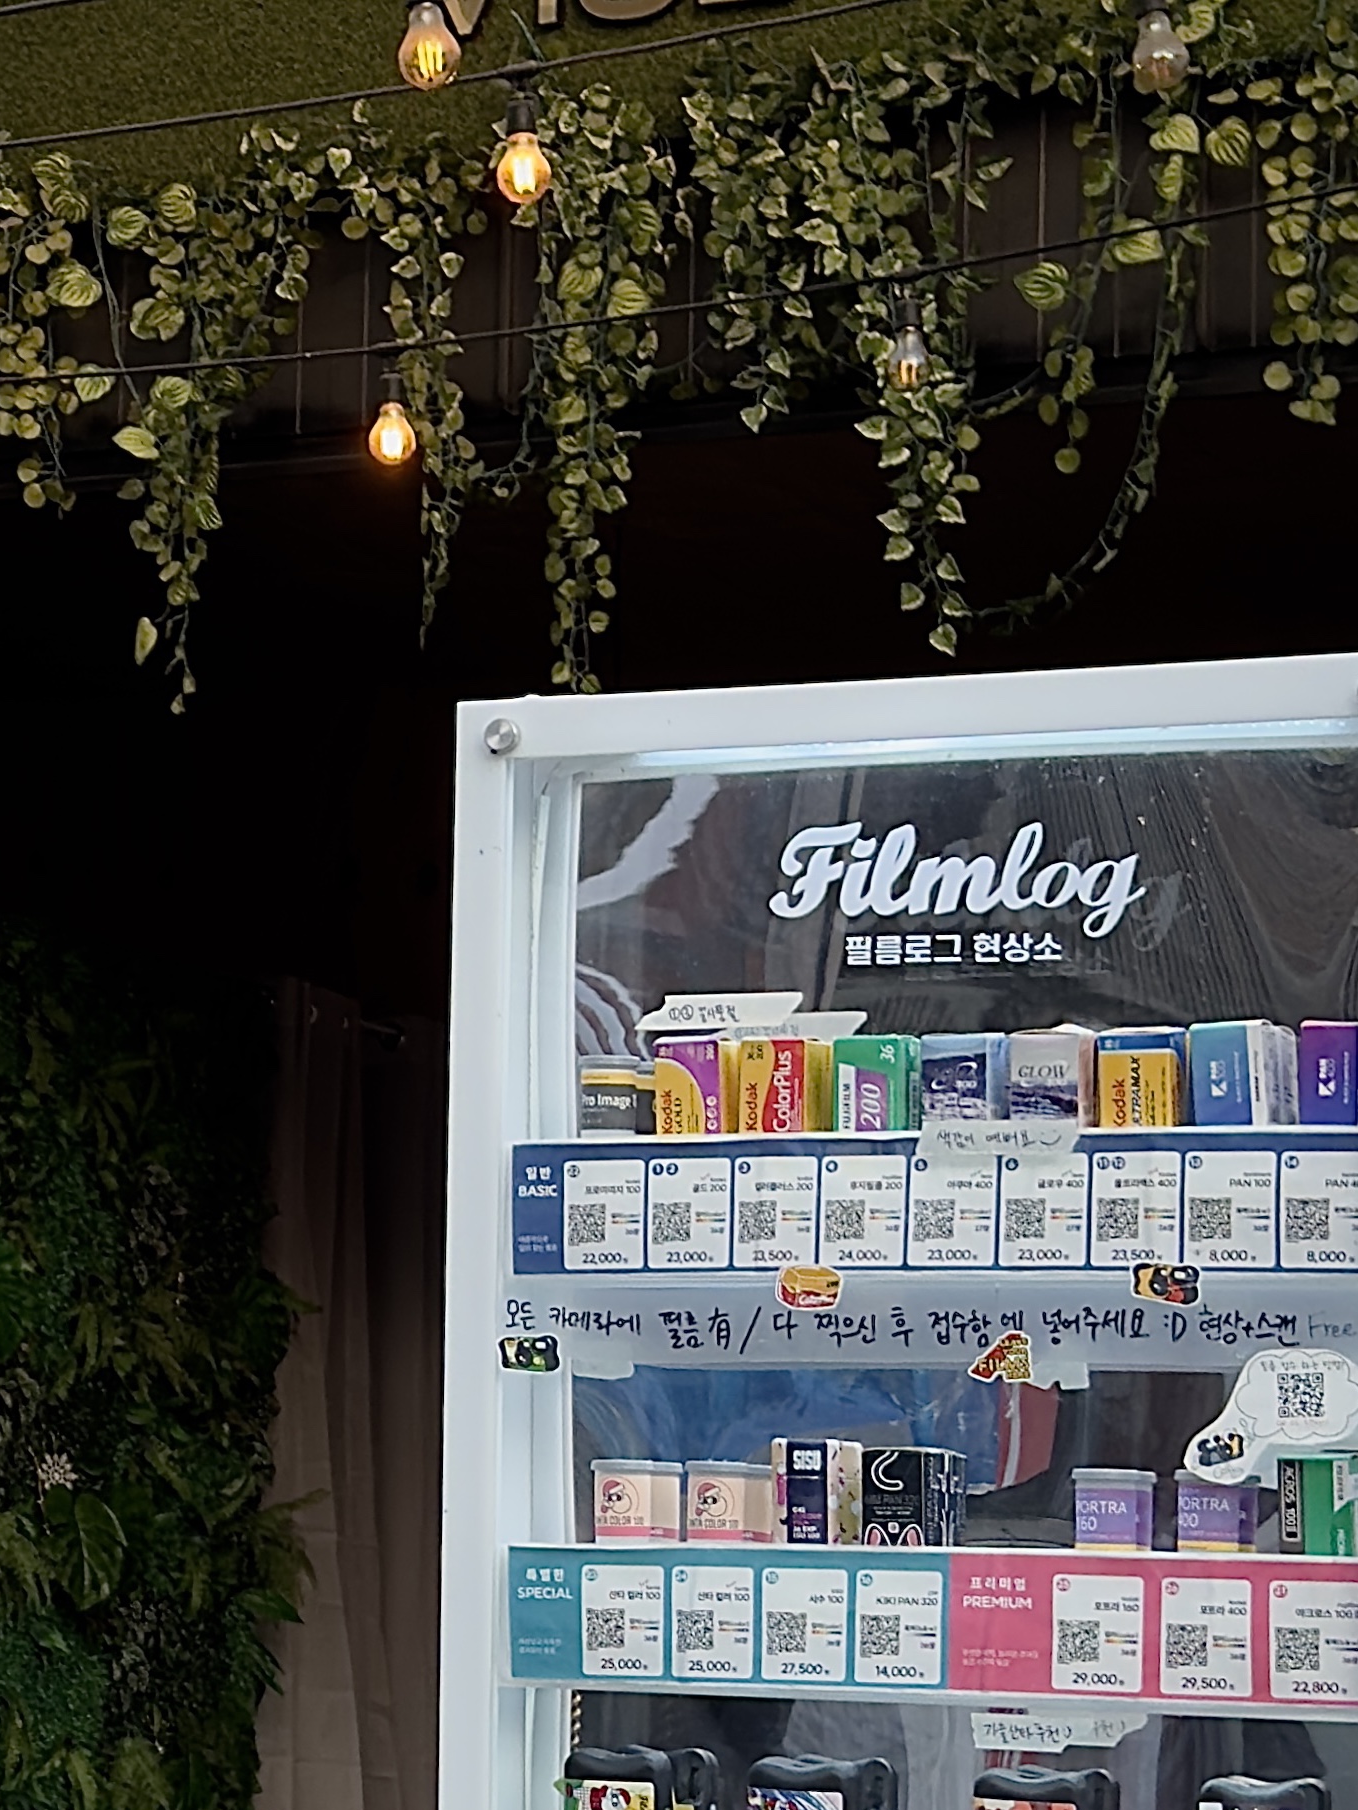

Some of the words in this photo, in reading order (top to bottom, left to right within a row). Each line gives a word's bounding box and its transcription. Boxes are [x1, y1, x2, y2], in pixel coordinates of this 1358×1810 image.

[769, 822, 1147, 938] Filmlog
[845, 934, 962, 965] 필름로그
[973, 933, 1062, 963] 현상소
[880, 1045, 895, 1064] 36
[1018, 1064, 1070, 1079] GLOW
[772, 1050, 793, 1133] ColorPlus
[597, 1095, 631, 1110] Image
[745, 1082, 758, 1132] Kodak
[860, 1083, 882, 1129] 200
[661, 1089, 673, 1134] Kodak
[525, 1166, 552, 1181] 일반
[626, 1184, 641, 1194] 100
[710, 1183, 727, 1192] 200
[796, 1182, 813, 1191] 200
[885, 1181, 902, 1190] 200
[974, 1179, 993, 1189] 400
[1065, 1179, 1084, 1188] 400
[1158, 1179, 1177, 1188] 400
[1229, 1179, 1251, 1188] PAN
[1254, 1179, 1271, 1188] 100
[1325, 1179, 1348, 1189] PAN
[518, 1185, 557, 1198] BASIC
[505, 1299, 535, 1331] 모든
[549, 1306, 641, 1336] 카메라에
[773, 1310, 798, 1340] 다
[813, 1313, 876, 1348] 찍으신
[890, 1306, 914, 1347] 후
[928, 1309, 992, 1347] 접수함
[1000, 1310, 1024, 1331] 에
[1042, 1306, 1150, 1346] 넣어주세요
[1307, 1309, 1358, 1339] Free
[793, 1450, 822, 1470] SISU
[1180, 1496, 1230, 1512] ORTRA
[610, 1516, 631, 1526] COLOR
[704, 1518, 727, 1530] COLOR
[970, 1577, 1026, 1592] 프리미엄
[517, 1586, 573, 1600] SPECIAL
[645, 1591, 660, 1600] 100
[733, 1592, 750, 1602] 100
[828, 1595, 844, 1604] 100
[898, 1597, 919, 1606] PAN
[962, 1595, 1032, 1610] PREMIUM
[1123, 1603, 1139, 1612] 160
[1228, 1607, 1247, 1616] 400
